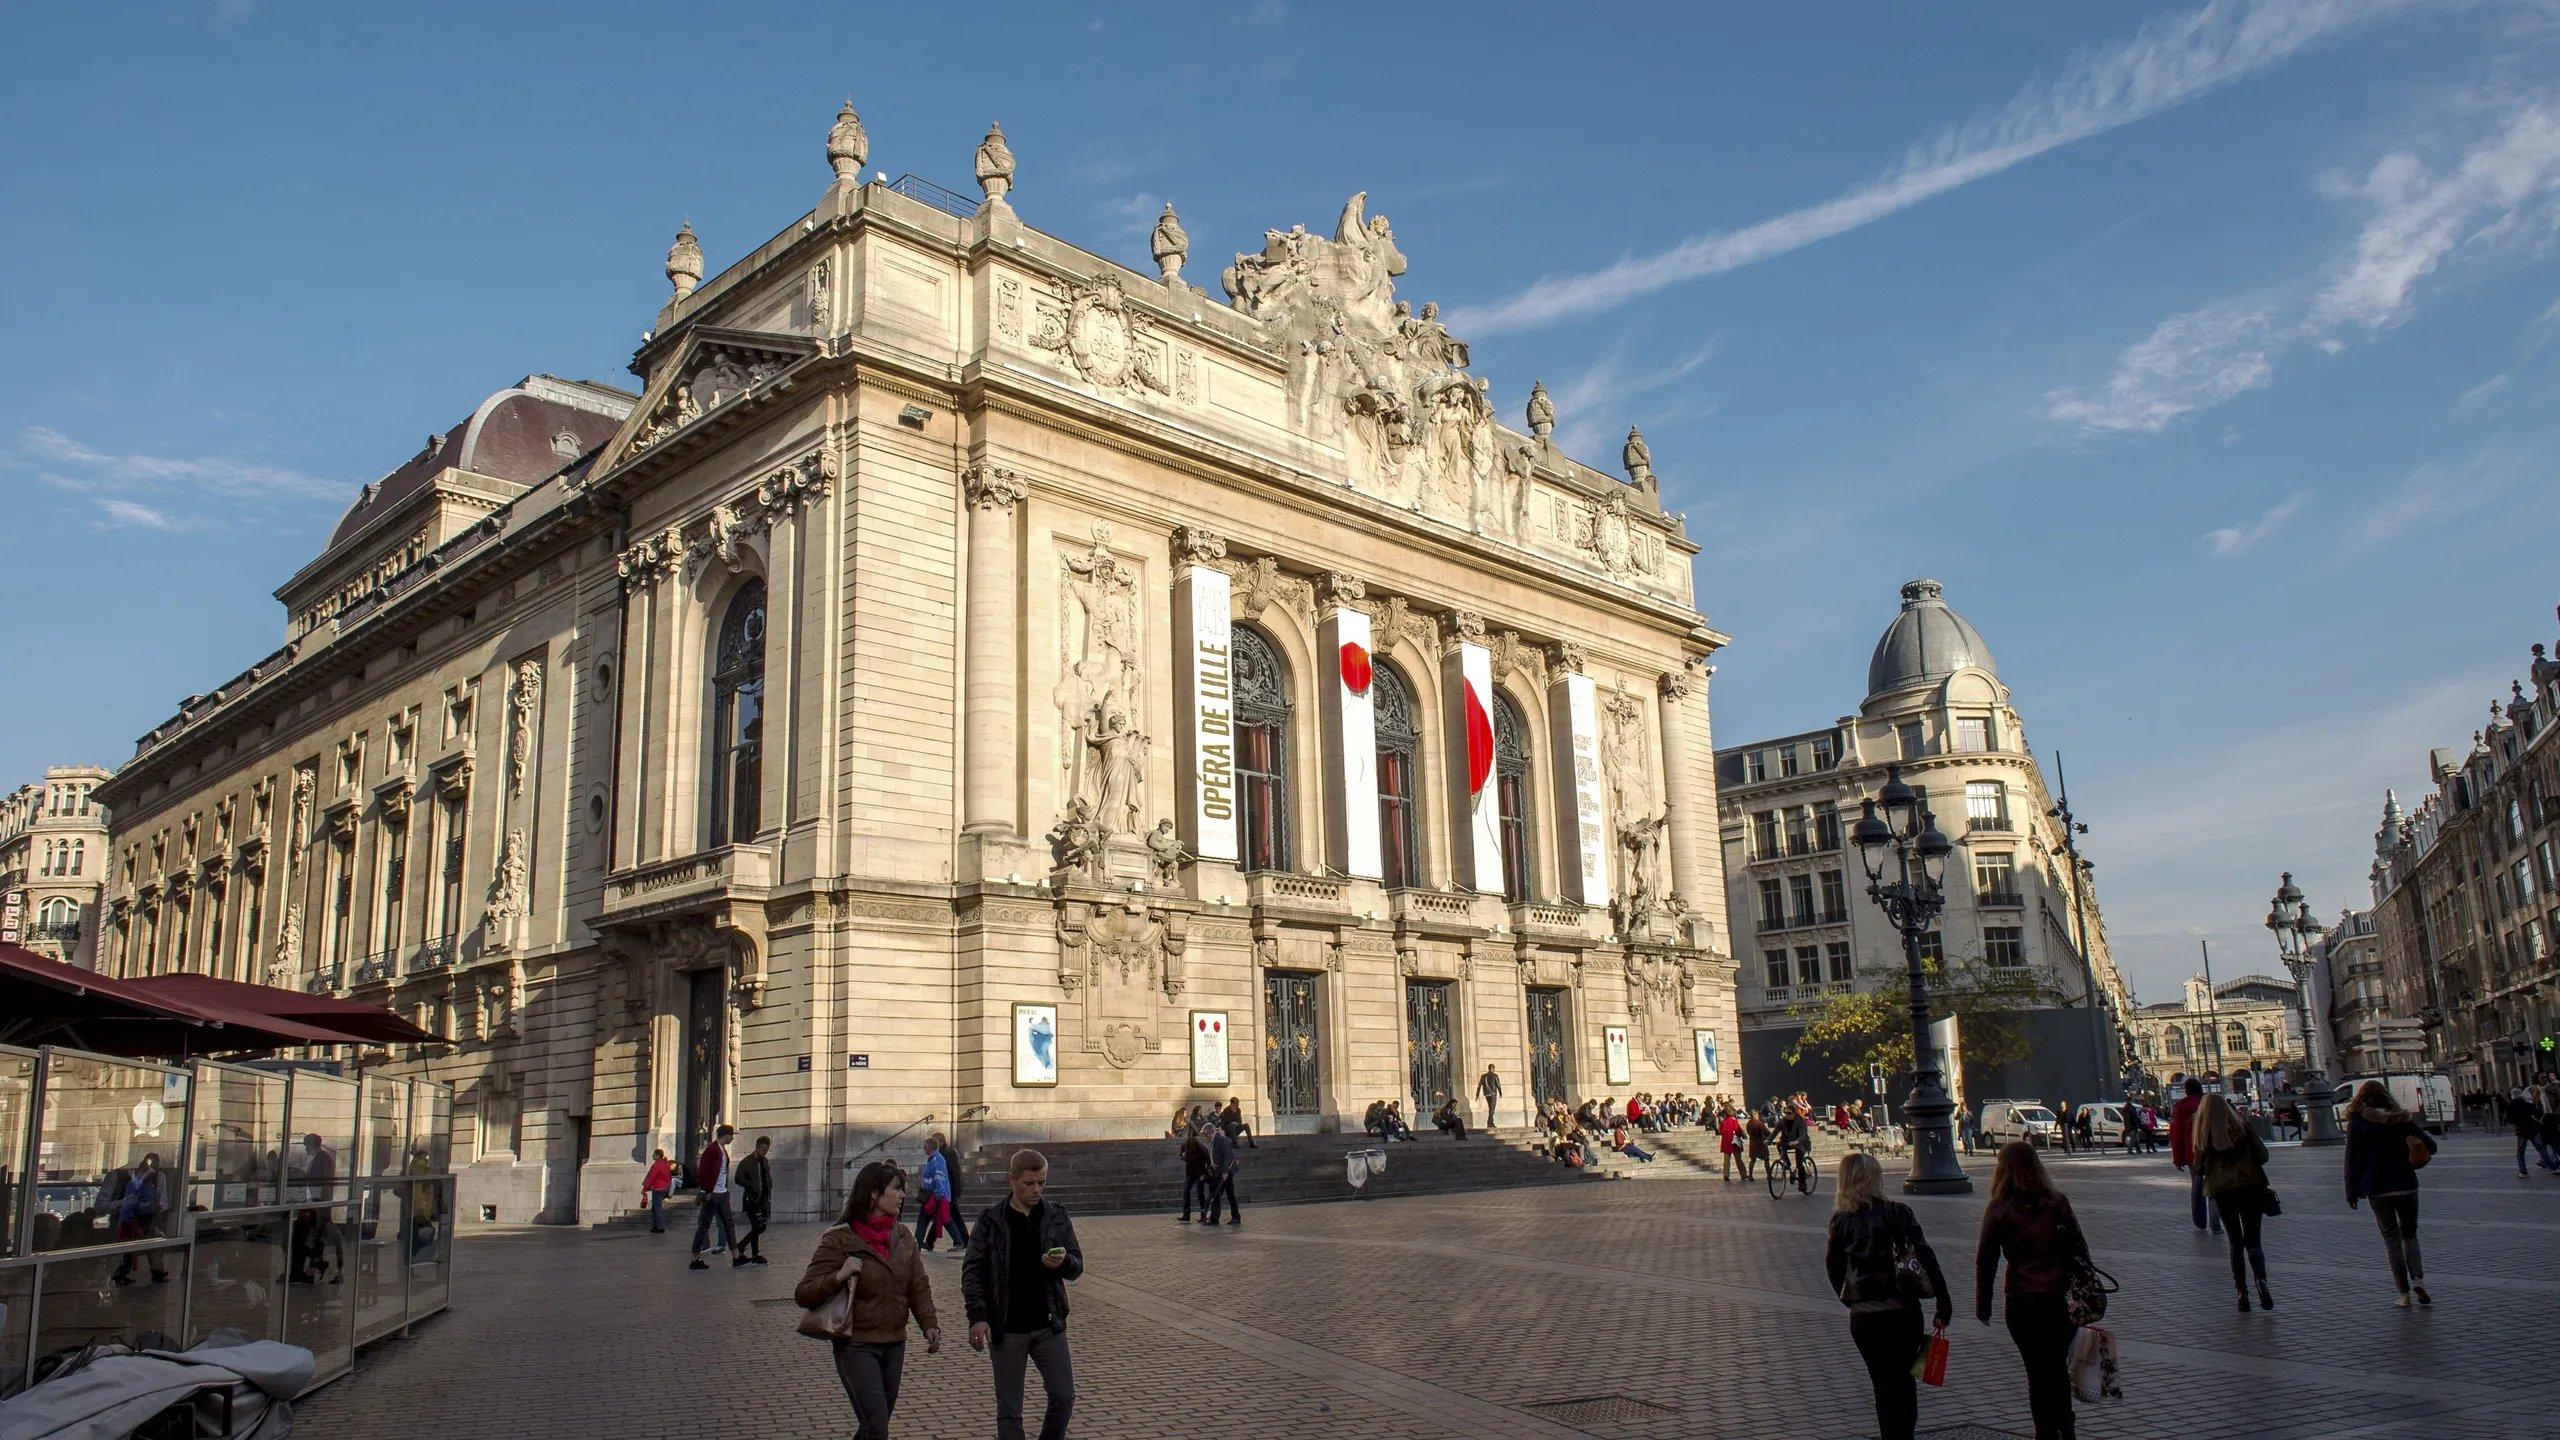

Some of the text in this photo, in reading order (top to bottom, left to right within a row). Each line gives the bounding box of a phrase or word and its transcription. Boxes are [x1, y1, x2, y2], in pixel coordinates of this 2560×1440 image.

[1200, 640, 1229, 701] LILLE
[1201, 705, 1230, 737] DE
[1197, 744, 1232, 820] OPÉRA
